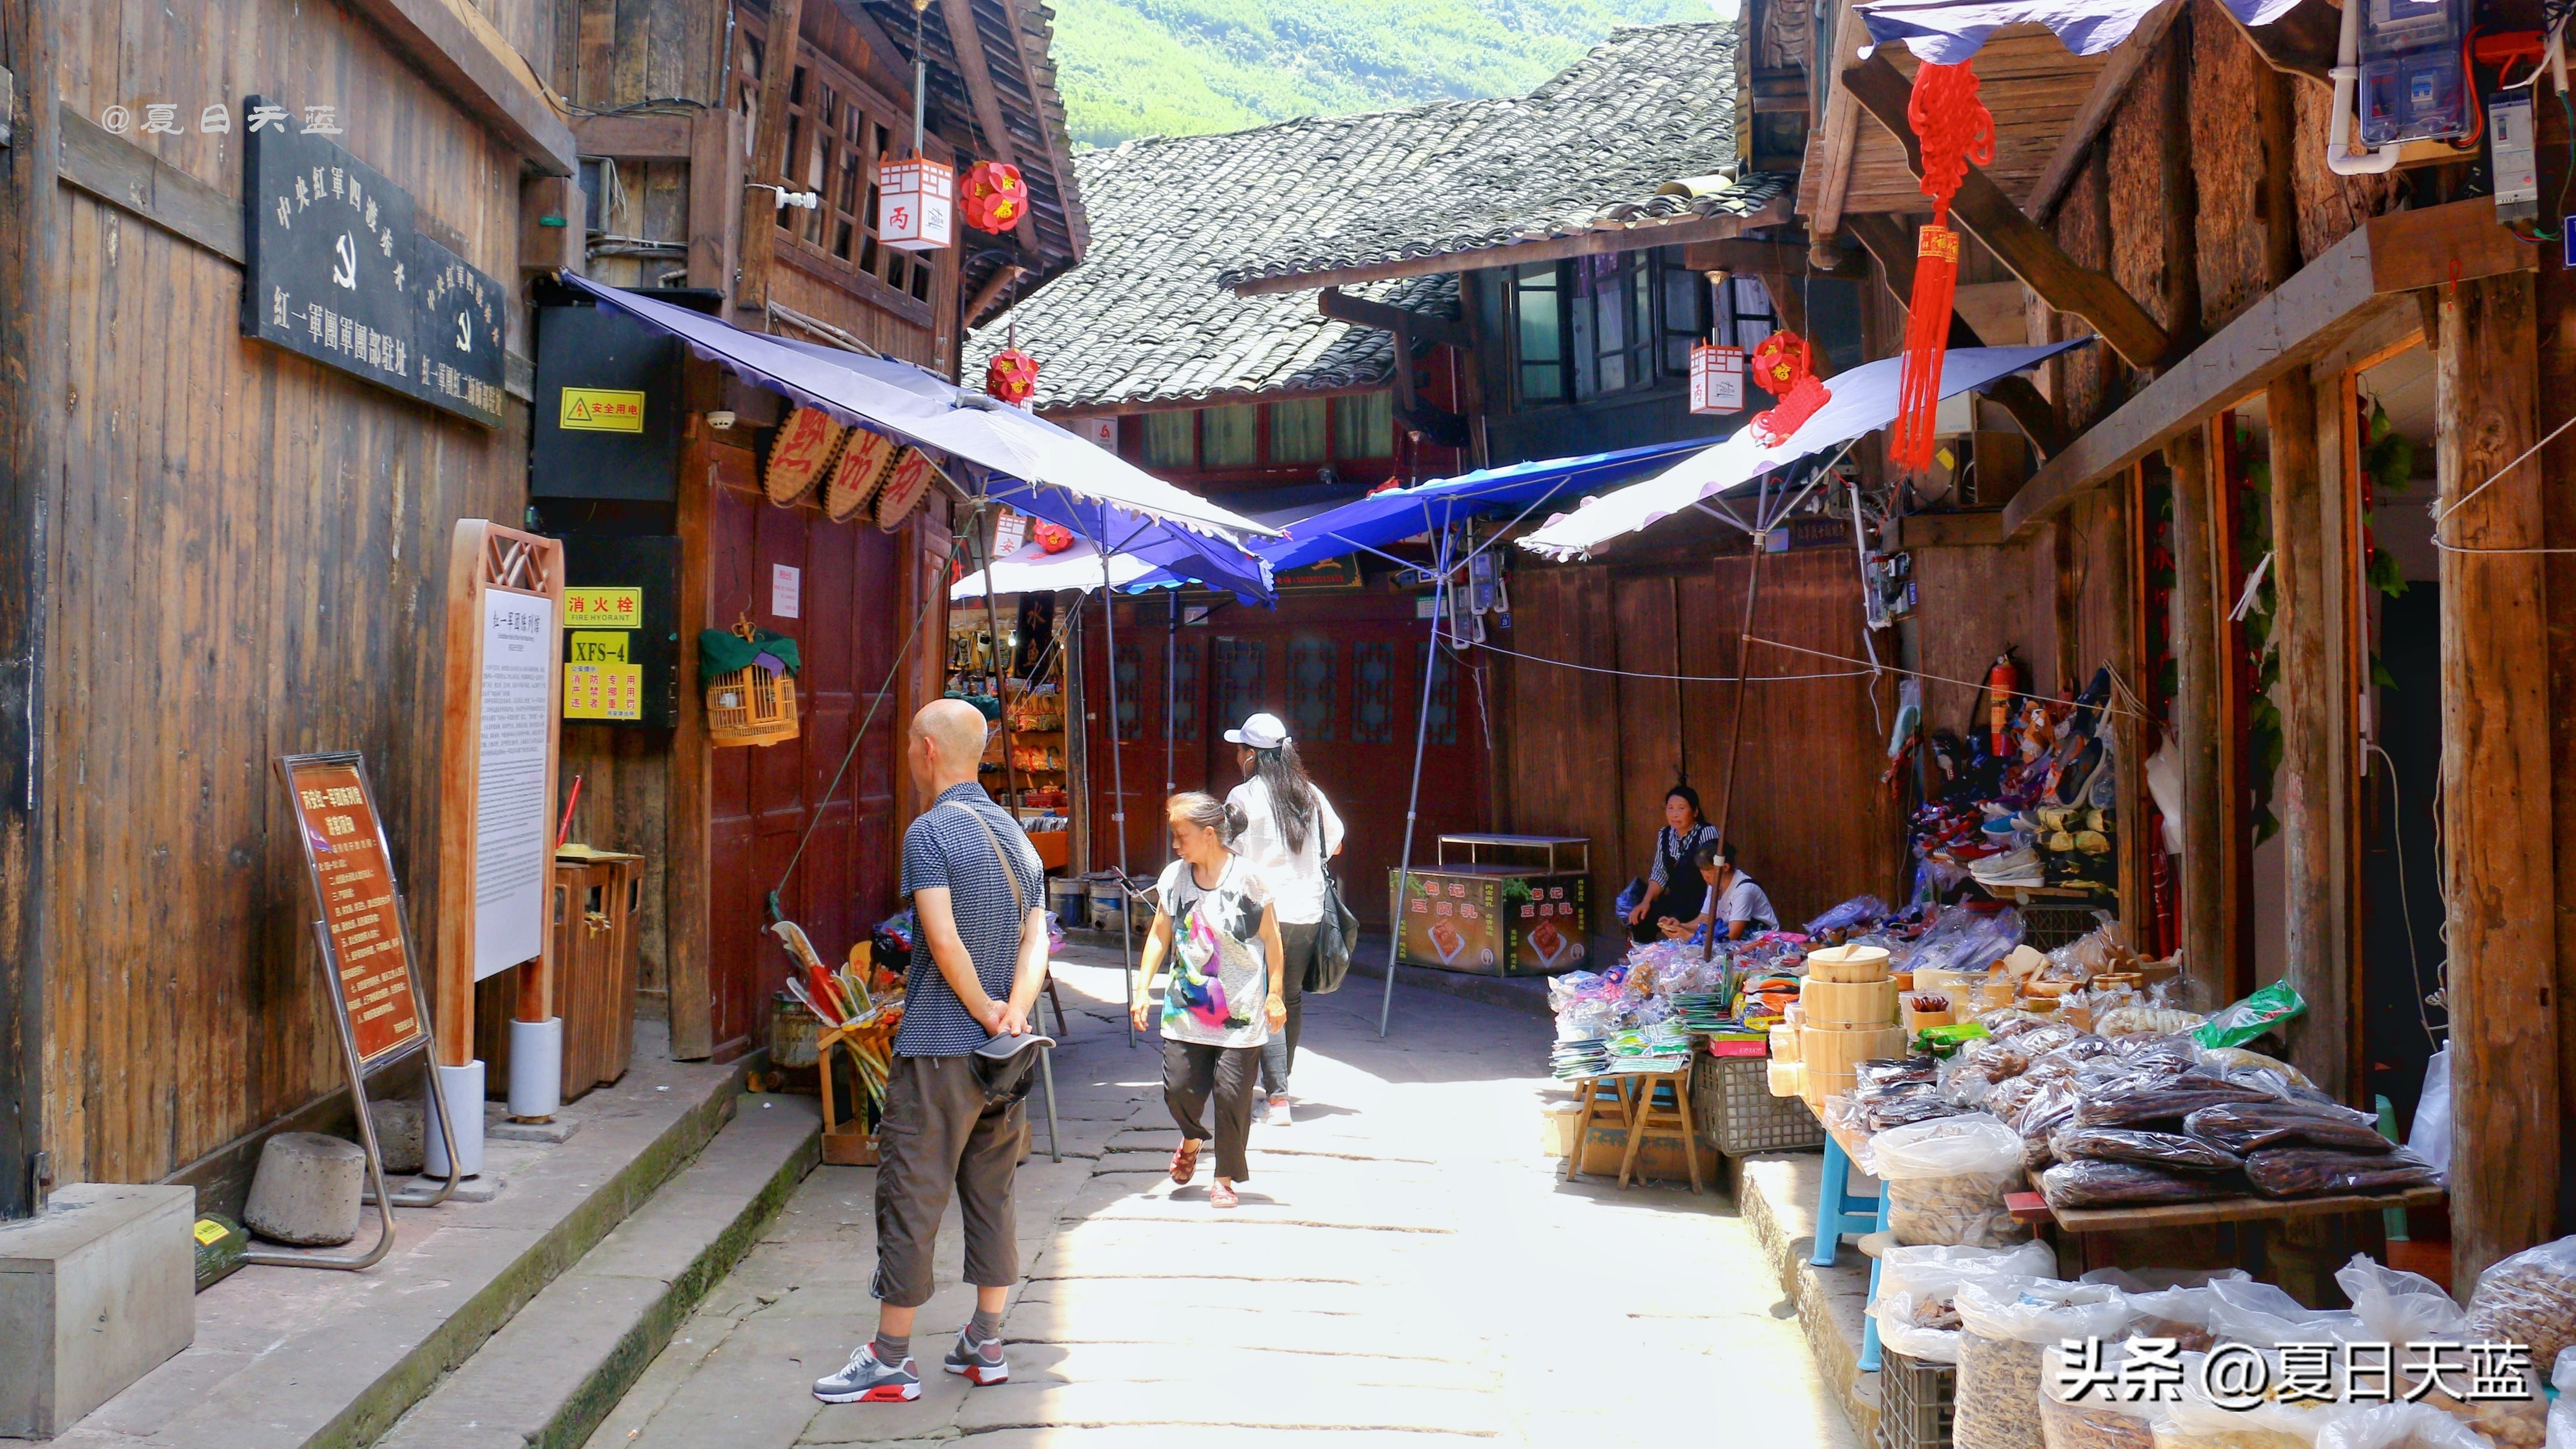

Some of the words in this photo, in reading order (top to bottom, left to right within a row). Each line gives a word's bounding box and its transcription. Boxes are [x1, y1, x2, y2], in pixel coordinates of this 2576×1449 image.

[889, 206, 909, 230] 丙
[592, 402, 638, 415] 安全用电
[999, 537, 1015, 553] 安
[569, 596, 633, 613] 消火栓
[576, 643, 625, 662] XFS-4
[571, 674, 635, 685] 消防专用
[571, 686, 635, 697] 严禁挪用
[571, 698, 635, 709] 违者重罚
[1424, 880, 1465, 898] 包记
[1411, 899, 1478, 919] 豆腐乳
[1521, 902, 1573, 917] 豆腐乳
